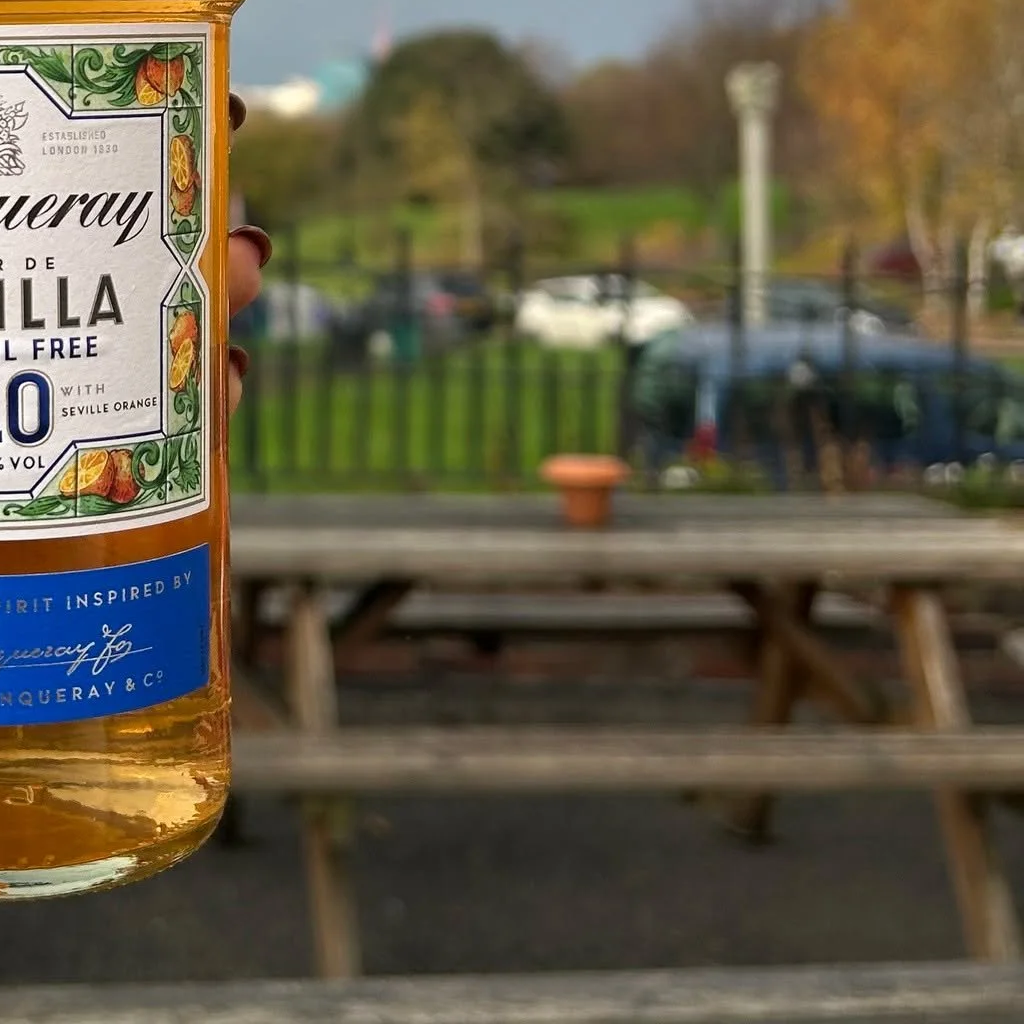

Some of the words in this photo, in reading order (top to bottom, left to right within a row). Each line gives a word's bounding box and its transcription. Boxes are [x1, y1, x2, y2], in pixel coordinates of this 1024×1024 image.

[42, 130, 106, 141] ESTABLISHED
[42, 144, 88, 156] LONDON
[93, 144, 119, 155] 1830
[25, 257, 56, 271] DE
[32, 335, 99, 360] FREE
[60, 383, 106, 397] WITH
[61, 403, 109, 418] SEVILLE
[113, 396, 158, 412] ORANGE
[10, 455, 46, 470] VOL
[65, 580, 165, 611] INSPIRED
[173, 570, 192, 589] BY
[126, 678, 136, 692] &
